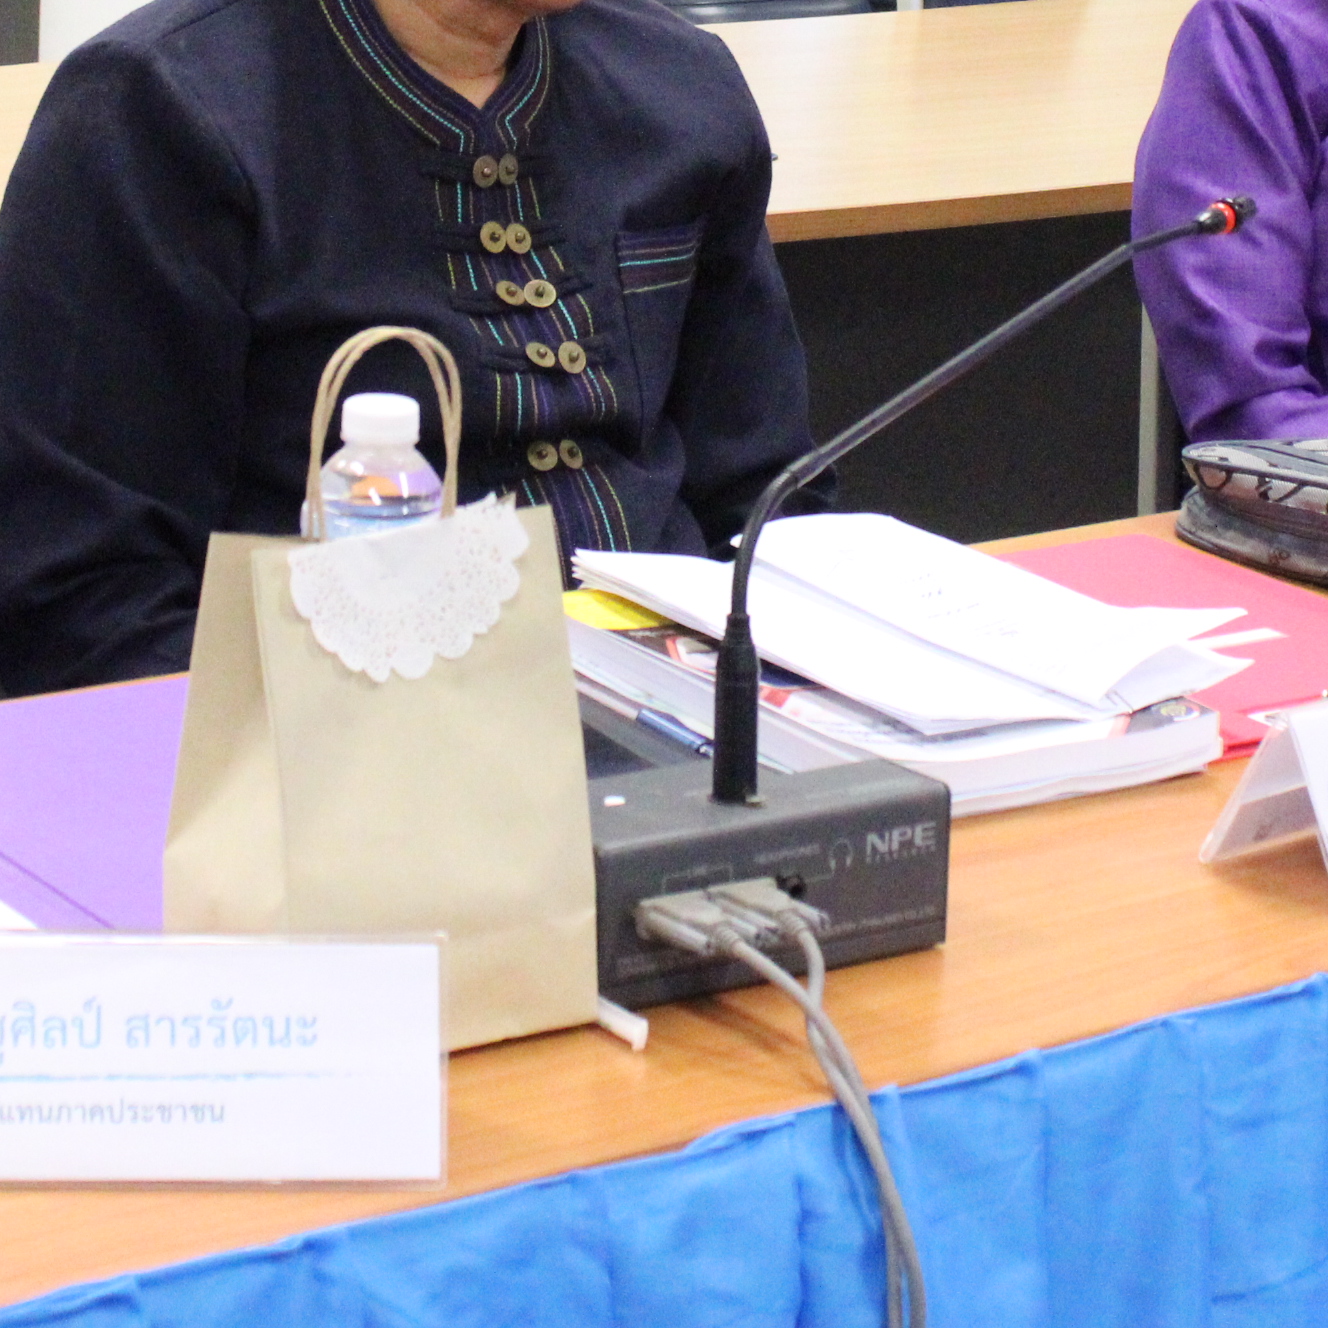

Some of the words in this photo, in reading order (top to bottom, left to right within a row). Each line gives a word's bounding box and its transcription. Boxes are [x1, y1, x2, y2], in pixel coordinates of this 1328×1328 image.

[866, 822, 936, 853] NPE
[124, 996, 320, 1050] สารรัตนะ
